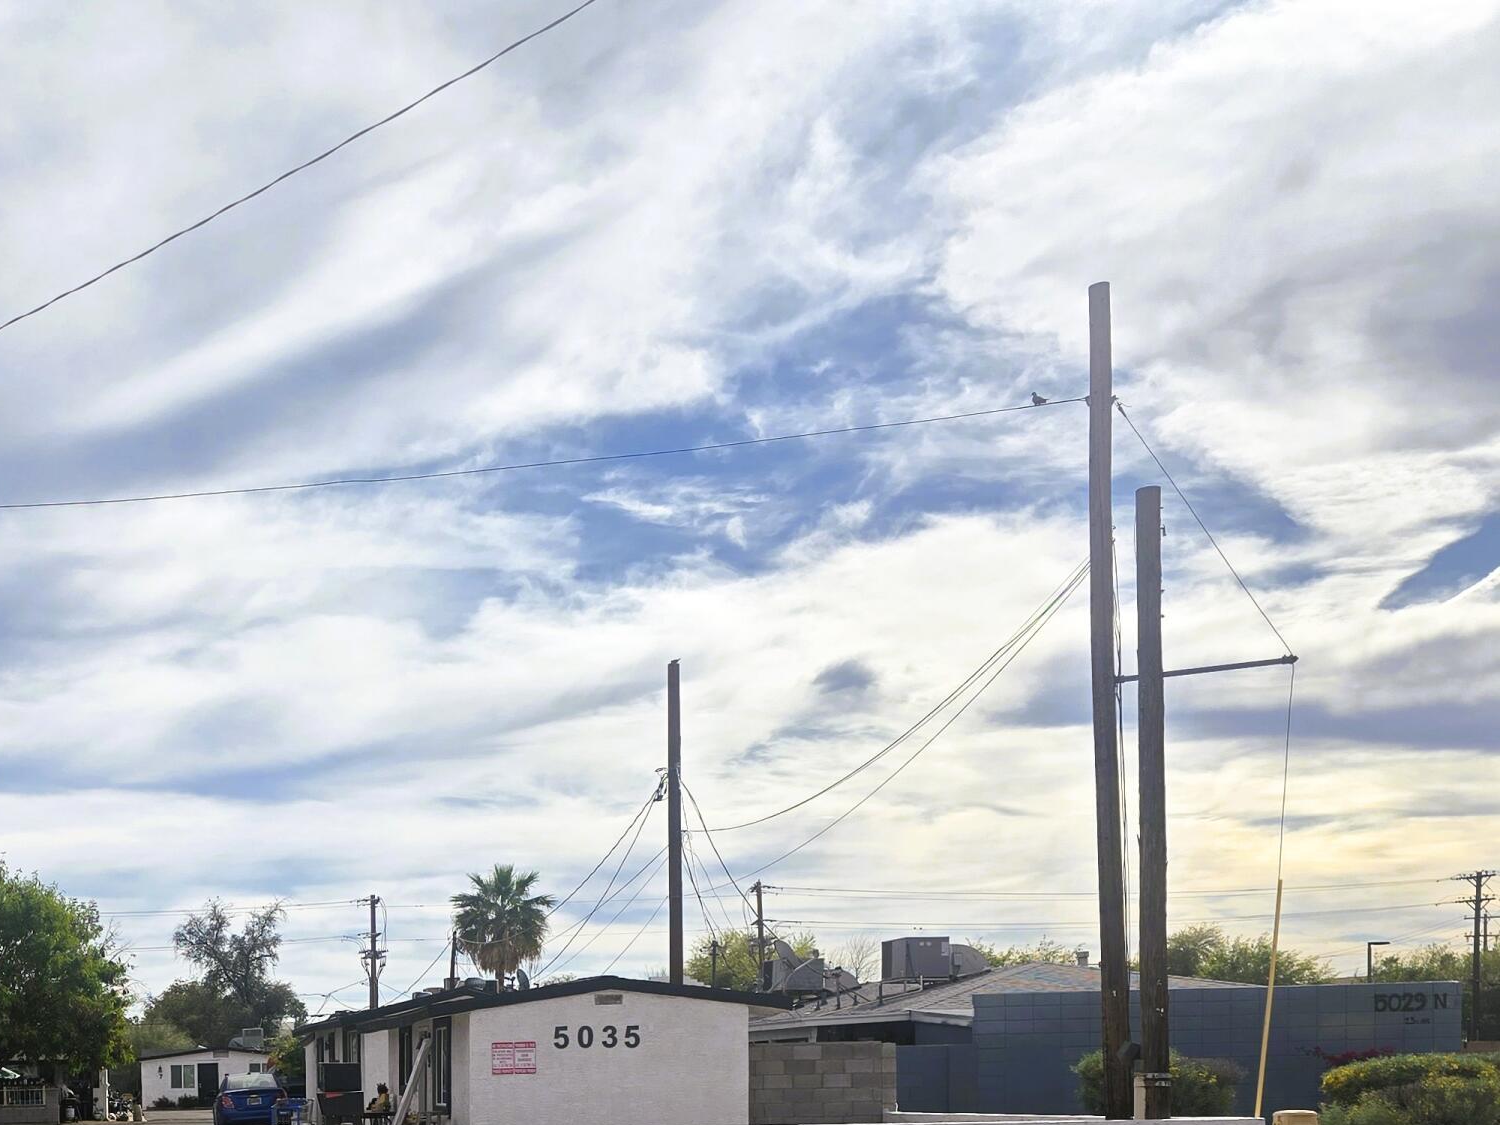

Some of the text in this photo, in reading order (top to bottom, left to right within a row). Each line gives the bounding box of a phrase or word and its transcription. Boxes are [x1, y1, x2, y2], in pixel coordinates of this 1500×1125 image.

[1374, 992, 1447, 1012] 5029 N
[553, 1025, 641, 1049] 5035
